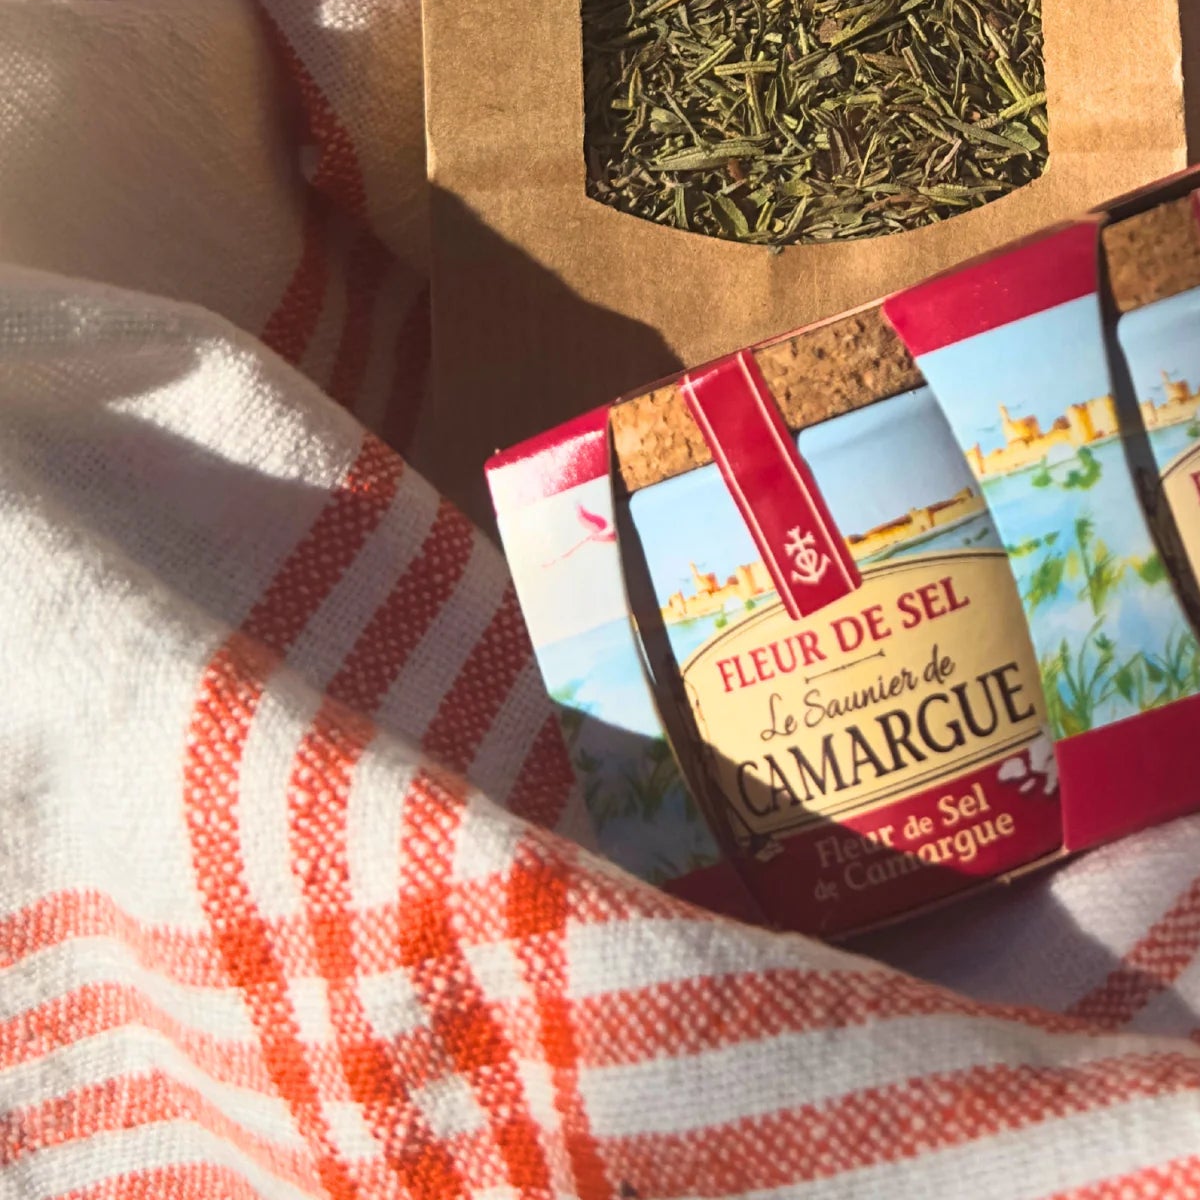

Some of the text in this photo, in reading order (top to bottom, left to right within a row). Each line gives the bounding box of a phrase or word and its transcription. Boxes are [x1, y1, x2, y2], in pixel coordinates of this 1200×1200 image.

[716, 576, 971, 693] FLEUR DE SEL
[735, 661, 1037, 818] CAMARGUE
[760, 643, 957, 742] Le Saunier de
[814, 782, 991, 869] Fleur de Sel
[814, 811, 1016, 902] de Camargue
